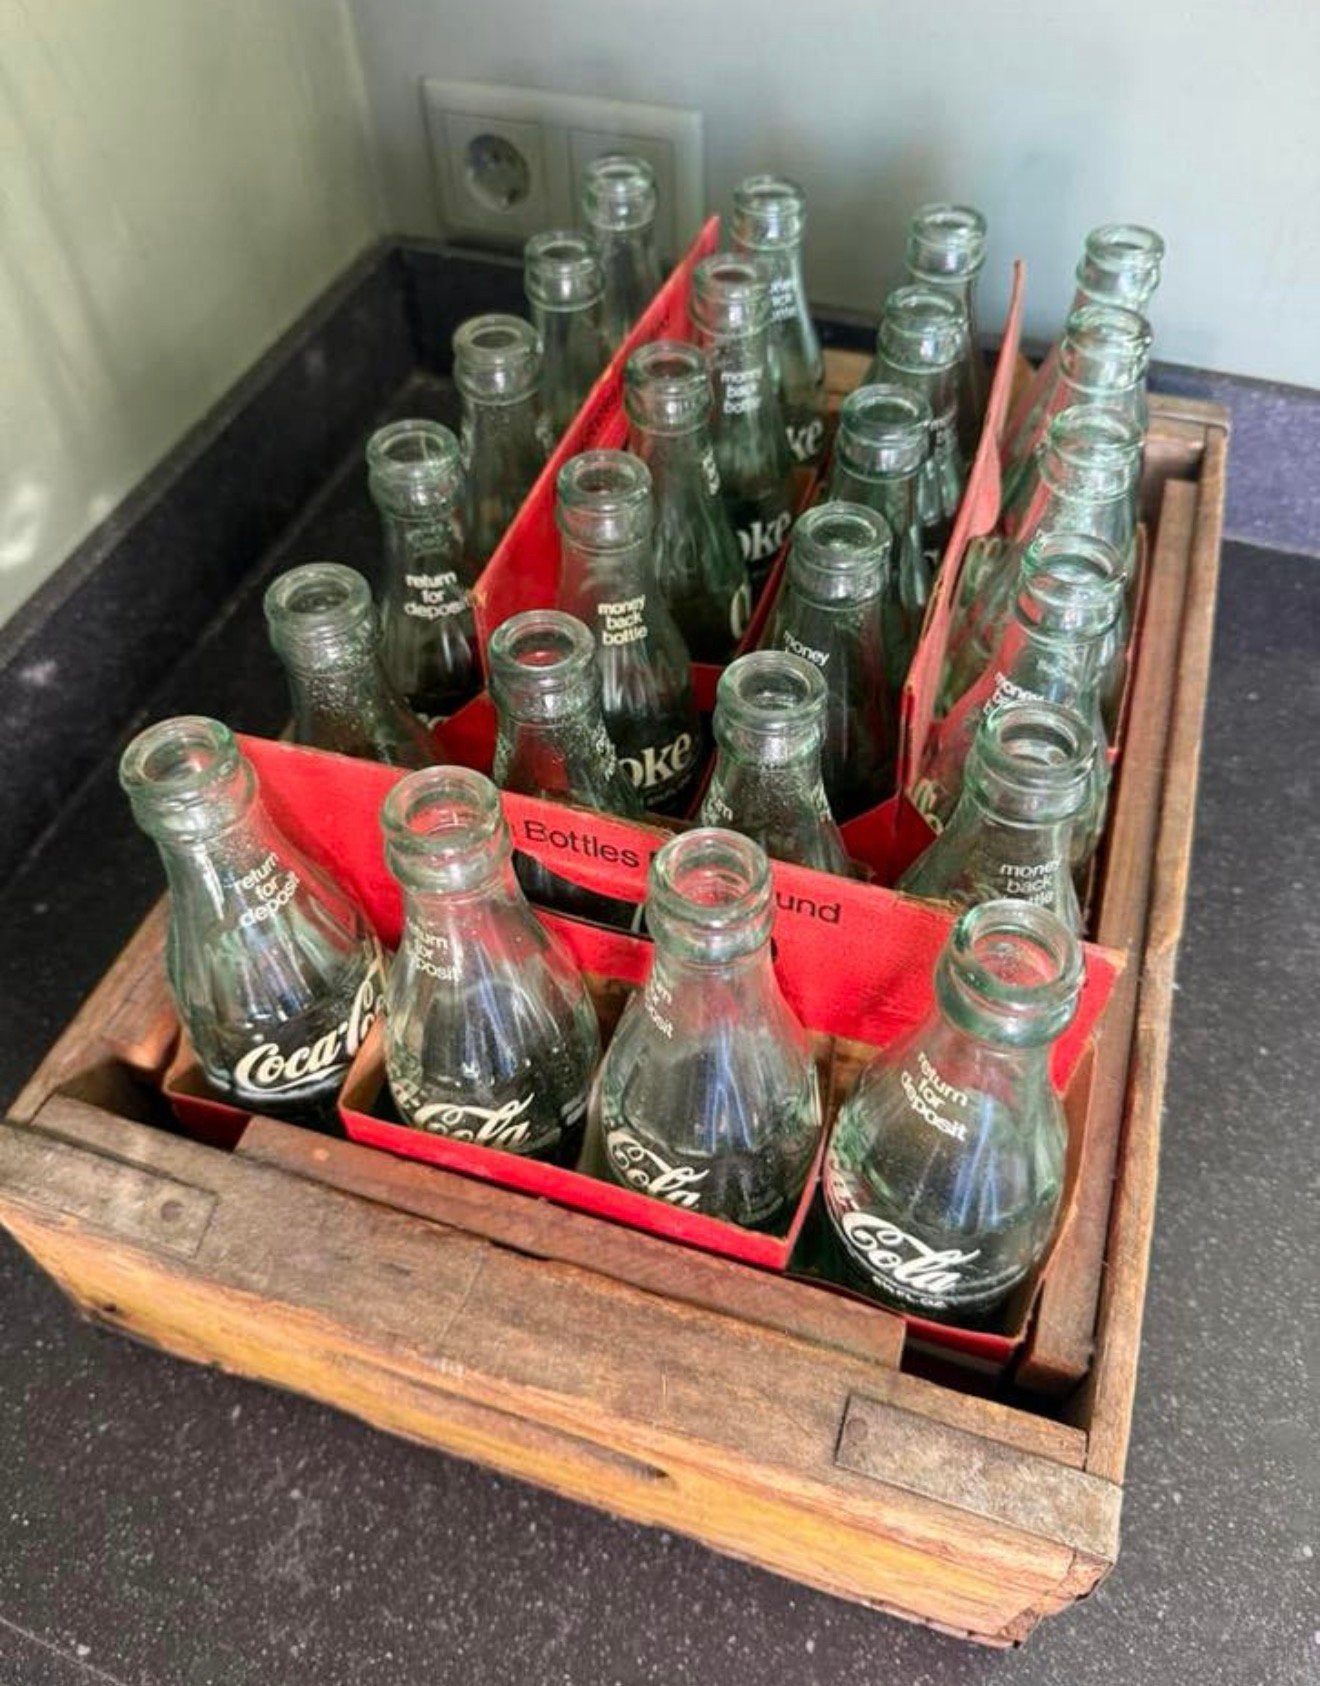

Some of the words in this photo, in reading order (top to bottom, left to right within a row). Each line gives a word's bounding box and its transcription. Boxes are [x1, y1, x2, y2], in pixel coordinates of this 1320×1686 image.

[405, 572, 458, 590] return
[421, 590, 445, 605] for
[597, 594, 646, 616] money
[606, 611, 642, 630] back
[602, 626, 648, 646] bottle
[618, 732, 692, 788] oke
[234, 852, 279, 896] return
[523, 819, 641, 869] Bottles
[775, 890, 842, 925] und
[256, 876, 279, 900] for
[918, 1052, 967, 1107] return
[901, 1070, 967, 1141] deposit
[918, 1078, 945, 1109] for
